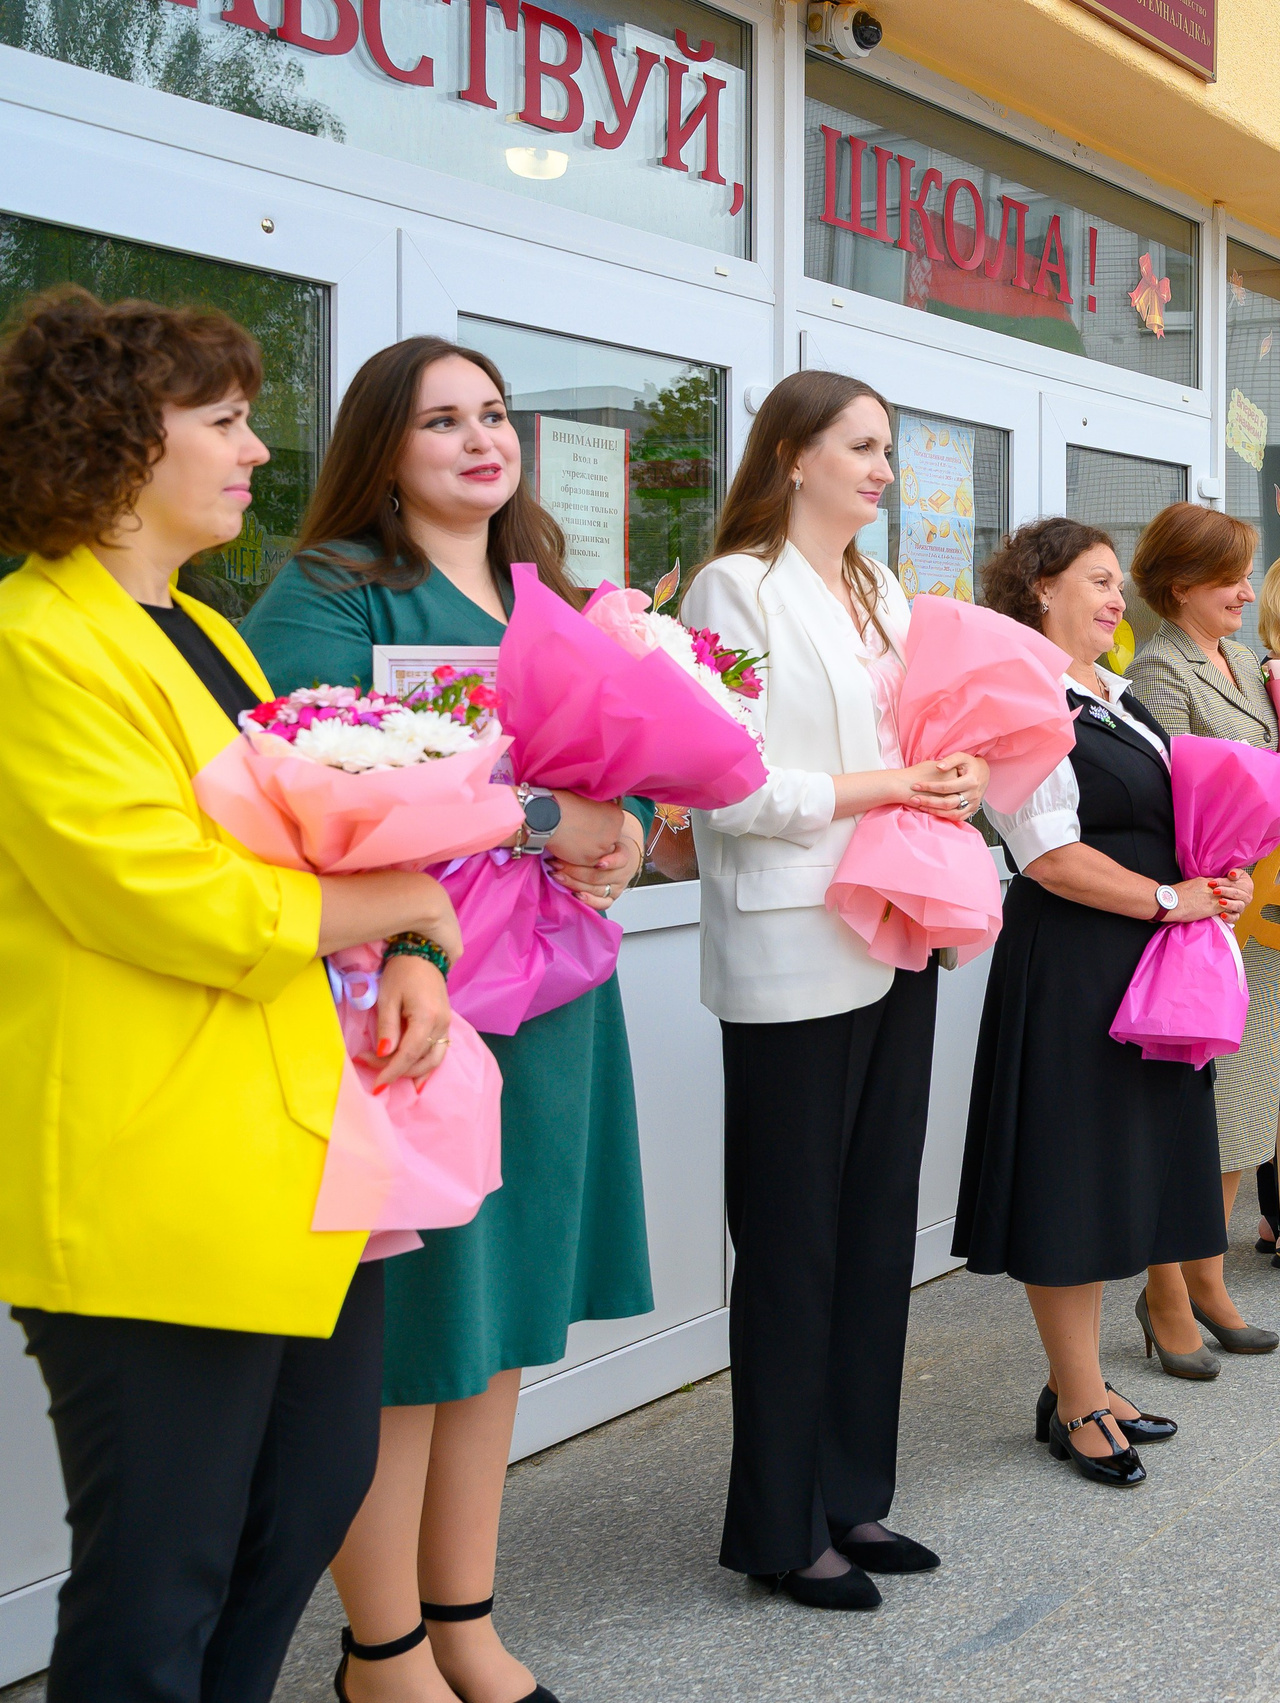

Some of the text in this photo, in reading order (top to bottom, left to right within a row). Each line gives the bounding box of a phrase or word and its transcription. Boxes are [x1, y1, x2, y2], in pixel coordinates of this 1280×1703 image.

[1180, 0, 1207, 17] ЩЕСТВО
[819, 123, 1098, 313] ШКОЛА!
[552, 430, 618, 451] ВНИМАНИЕ!
[572, 452, 592, 465] Вход
[561, 469, 609, 482] учреждение
[560, 484, 610, 498] образования
[551, 500, 619, 515] разрешен только
[560, 516, 609, 529] учащимся и
[569, 548, 601, 558] школы.
[227, 546, 258, 583] НЕТ
